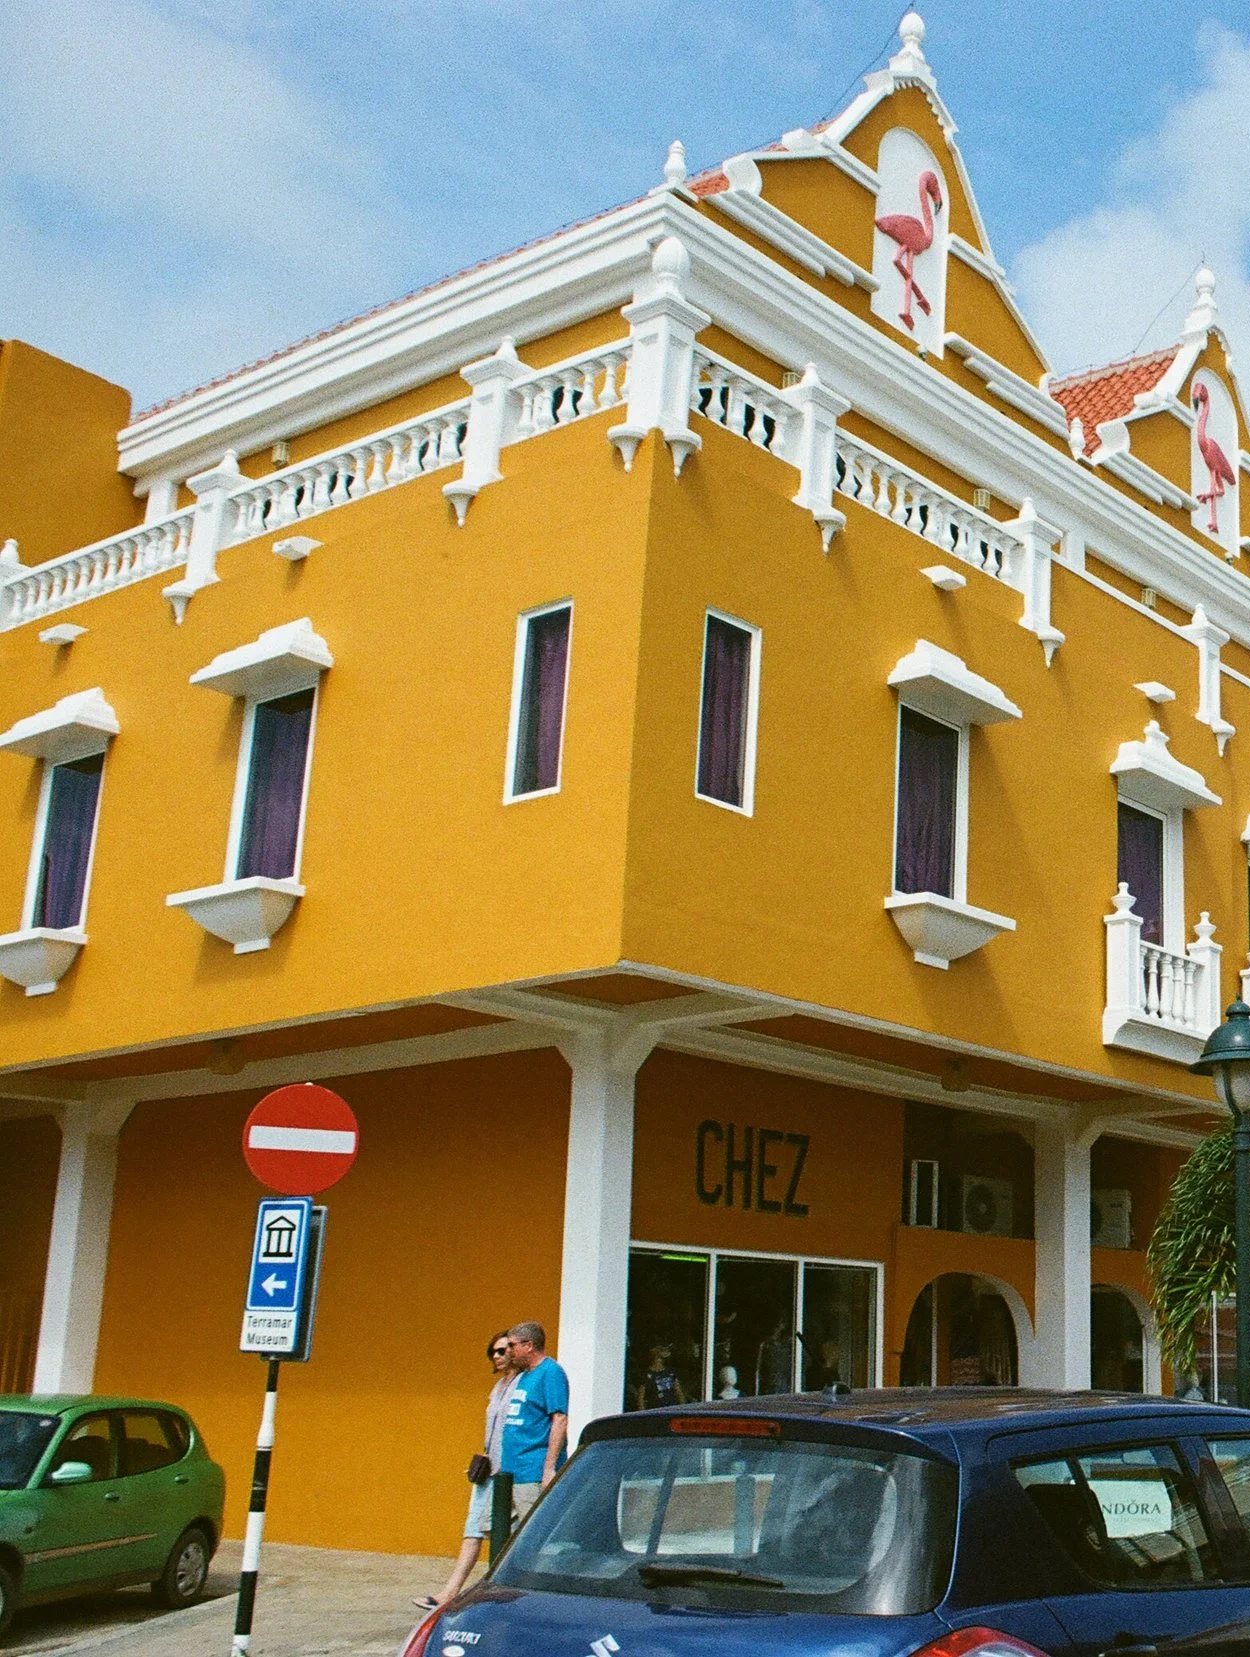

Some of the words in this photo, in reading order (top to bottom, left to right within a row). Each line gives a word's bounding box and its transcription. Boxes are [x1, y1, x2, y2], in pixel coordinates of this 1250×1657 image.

[696, 1119, 810, 1217] CHEZ
[247, 1315, 293, 1329] Terramar
[246, 1332, 289, 1345] Museum
